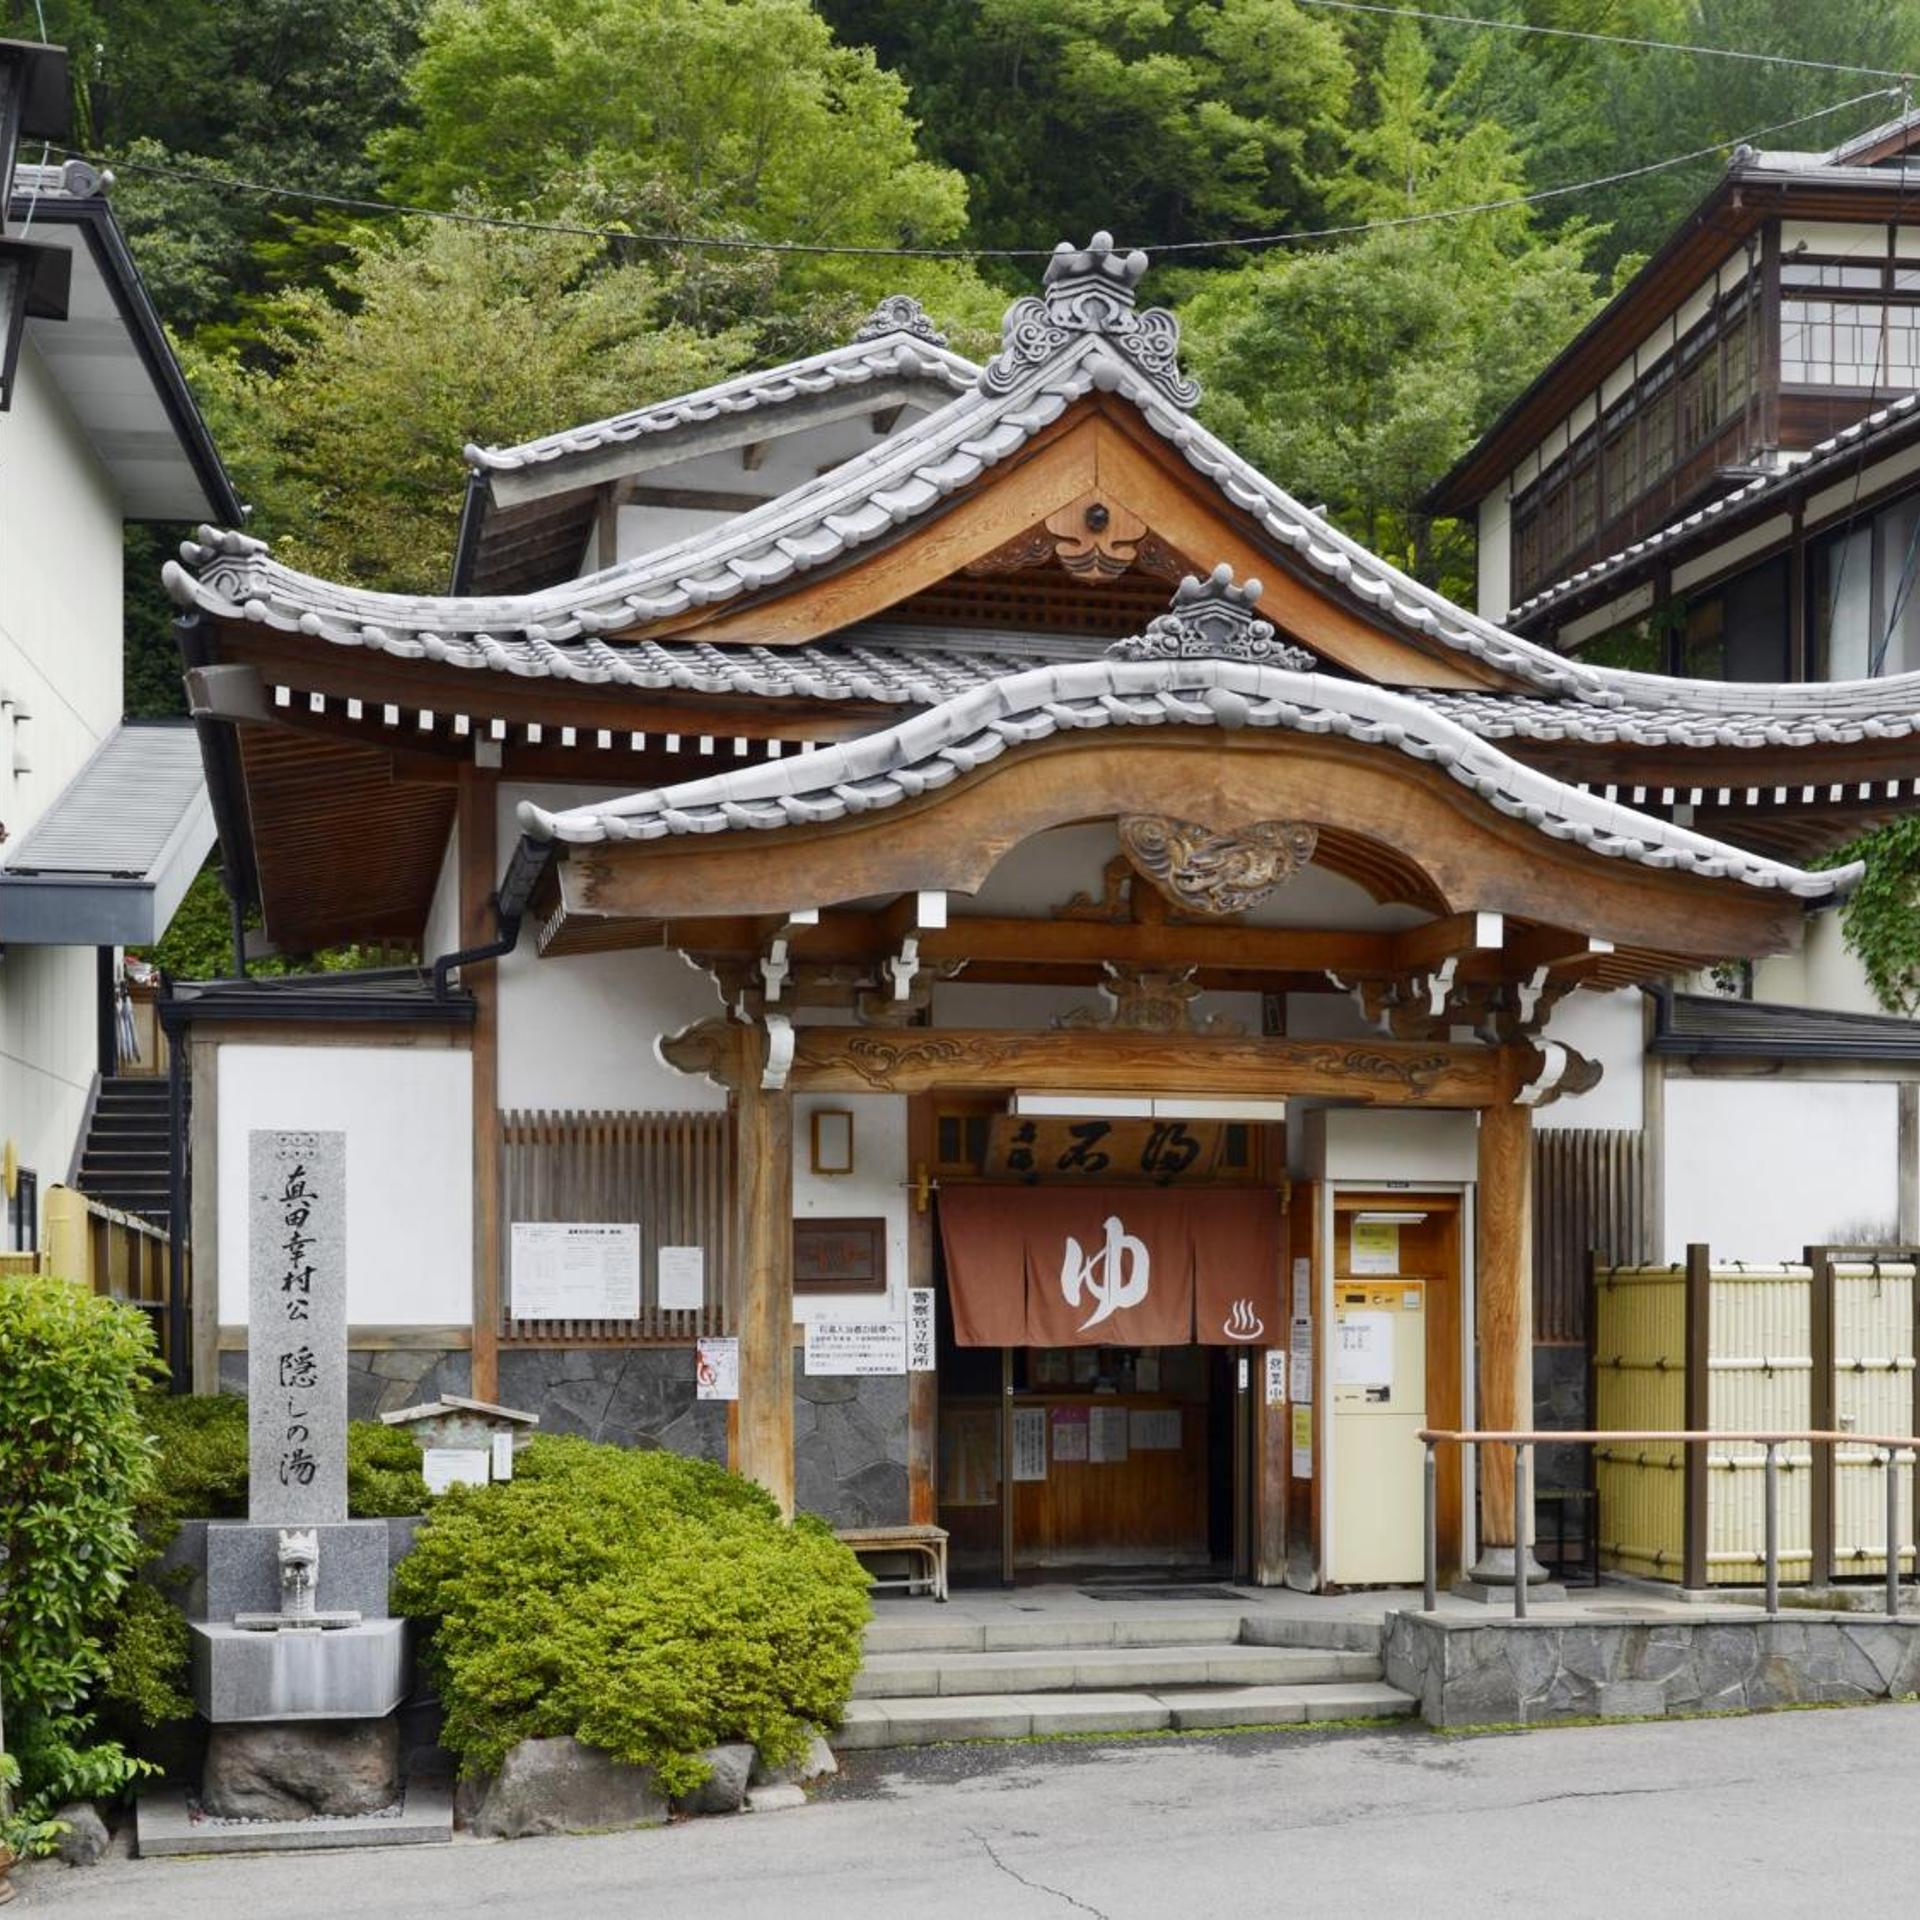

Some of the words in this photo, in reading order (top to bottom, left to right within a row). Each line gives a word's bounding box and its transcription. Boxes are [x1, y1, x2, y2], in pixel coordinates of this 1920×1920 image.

[1060, 1215, 1151, 1334] ゆ
[279, 1345, 318, 1487] 隠しの湯
